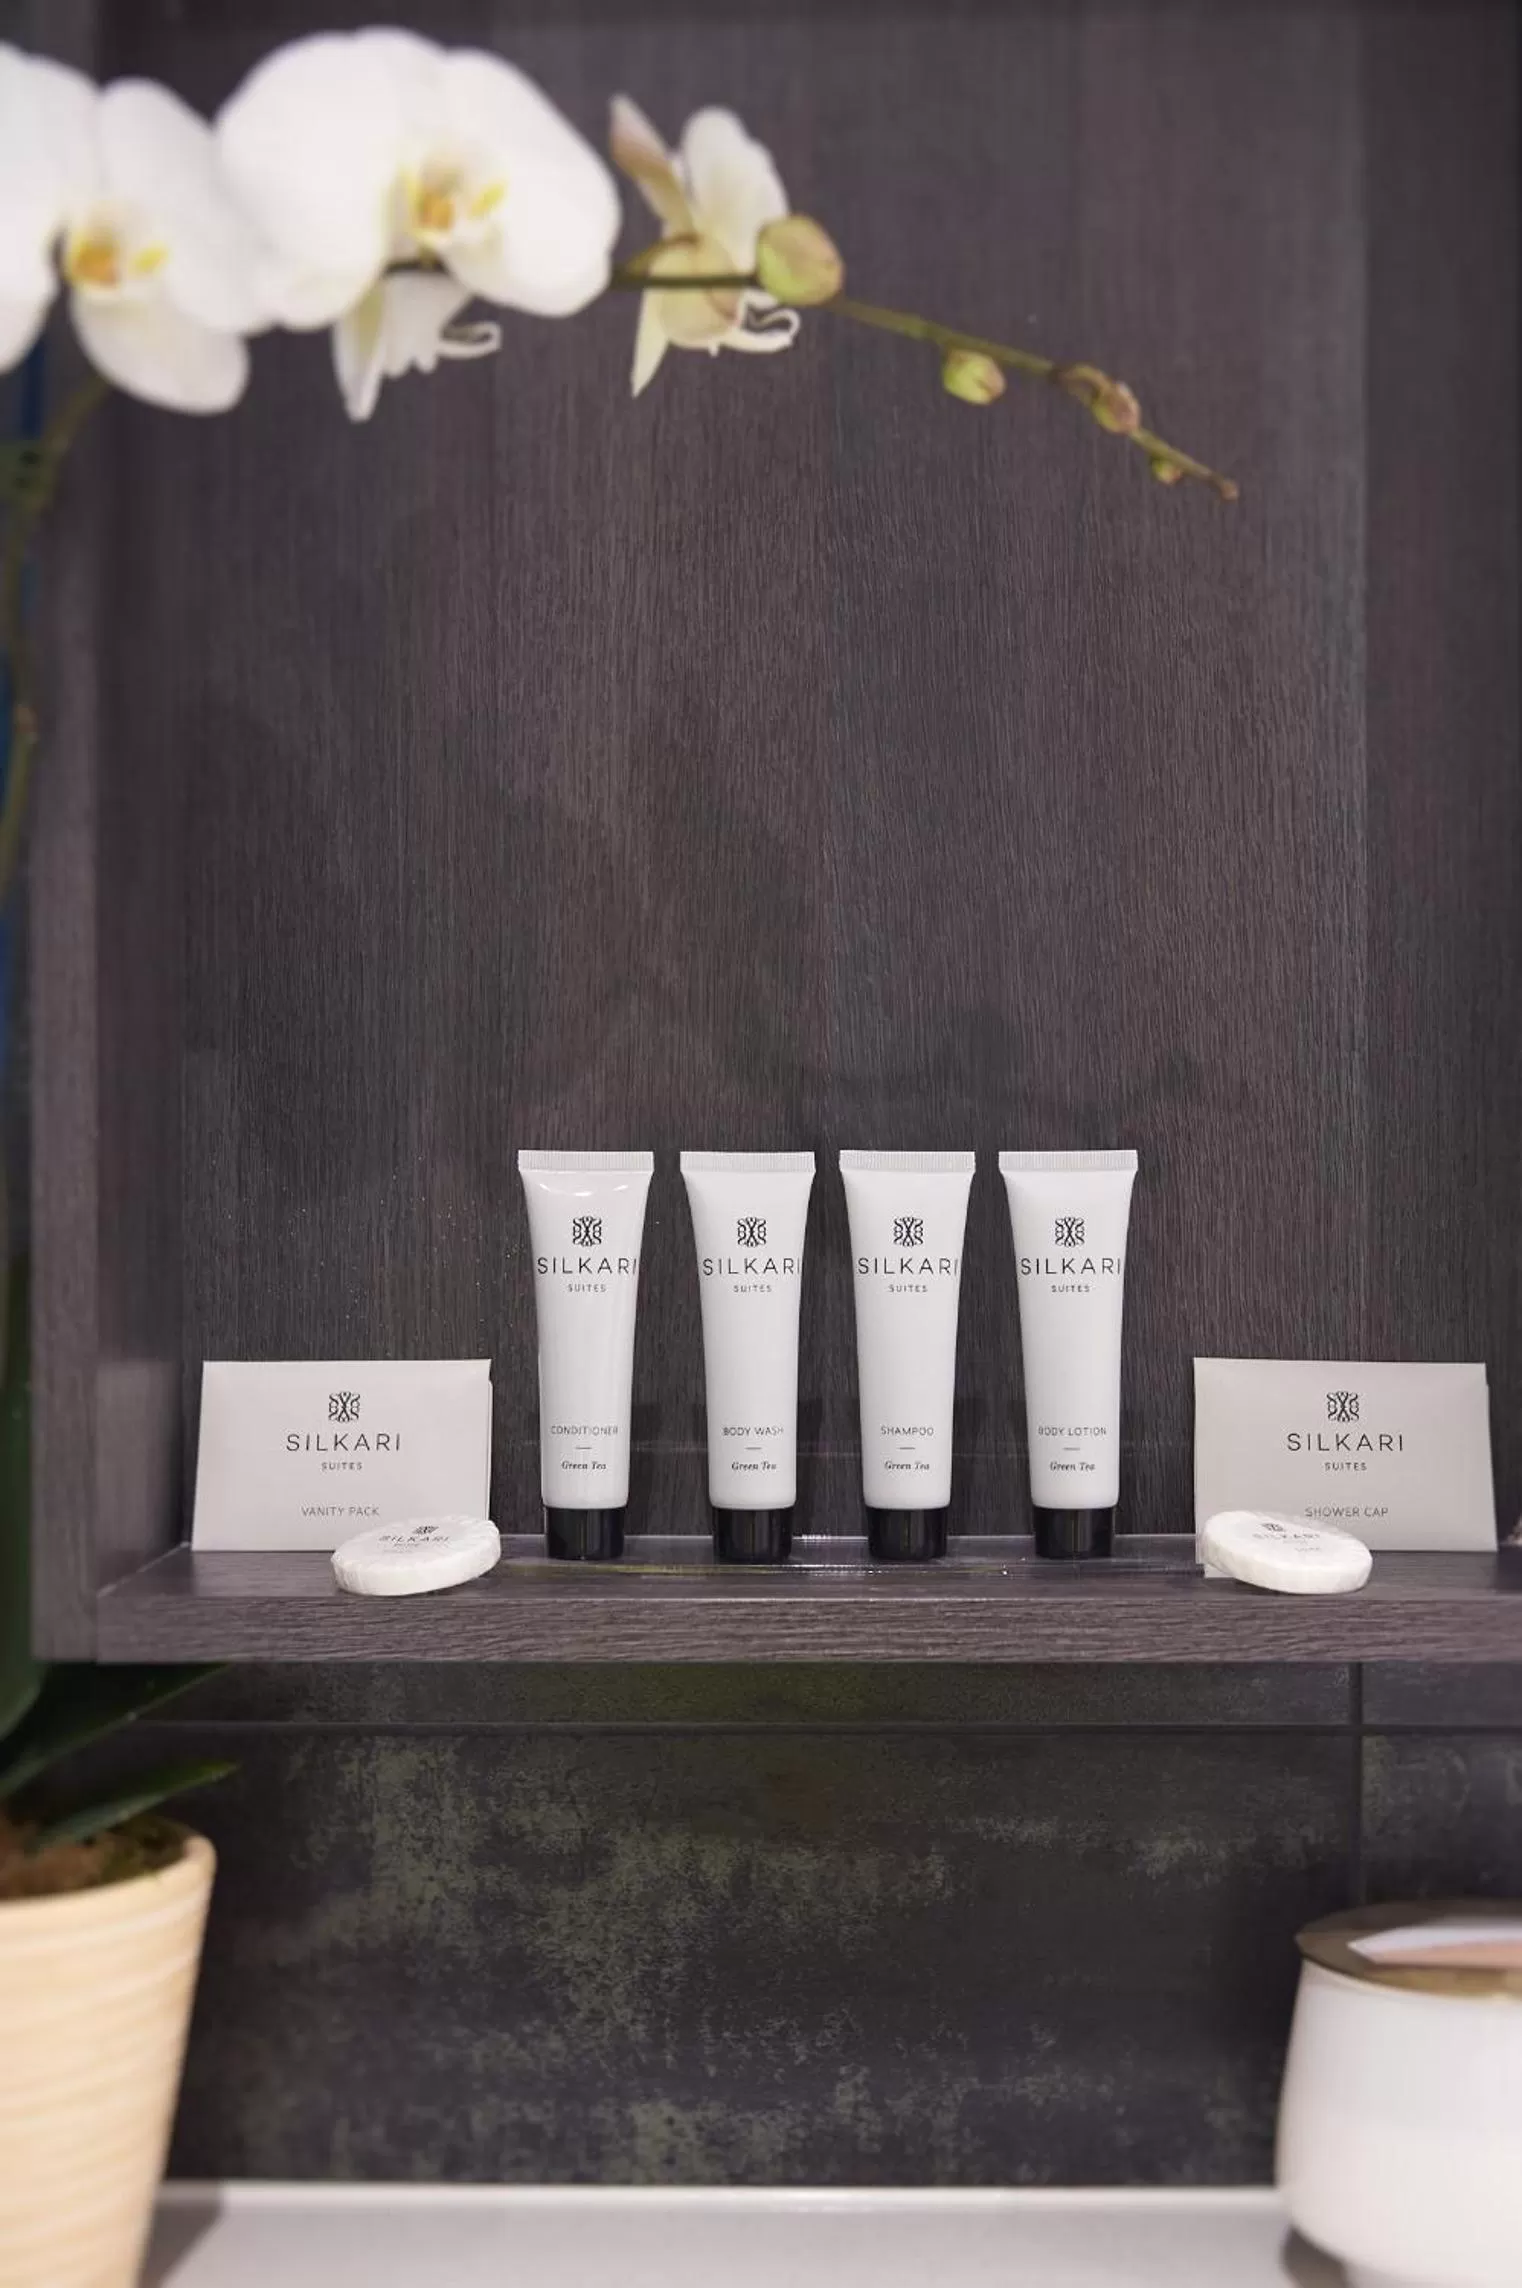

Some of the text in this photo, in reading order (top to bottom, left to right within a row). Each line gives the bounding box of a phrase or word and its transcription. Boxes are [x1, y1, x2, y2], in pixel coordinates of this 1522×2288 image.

[537, 1257, 636, 1275] SILKARI
[703, 1257, 800, 1275] SILKARI
[858, 1257, 958, 1275] SILKARI
[1020, 1257, 1120, 1275] SILKARI
[567, 1284, 607, 1293] SUITES
[733, 1284, 772, 1293] SUITES
[888, 1284, 928, 1293] SUITES
[1051, 1284, 1090, 1293] SUITES
[723, 1427, 784, 1436] BODY WASH
[880, 1426, 934, 1436] SHAMPOO
[1038, 1427, 1106, 1436] BODY LOTION
[286, 1433, 400, 1451] SILKARI
[1287, 1433, 1403, 1451] SILKARI
[321, 1462, 363, 1471] SUITES
[561, 1460, 607, 1470] Green Tea
[731, 1460, 777, 1470] Green Tea
[884, 1460, 930, 1470] Green Tea
[1050, 1460, 1095, 1470] Green Tea
[1325, 1462, 1367, 1471] SUITES
[301, 1507, 379, 1516] VANITY PACK
[1305, 1507, 1388, 1517] SHOWER CAP
